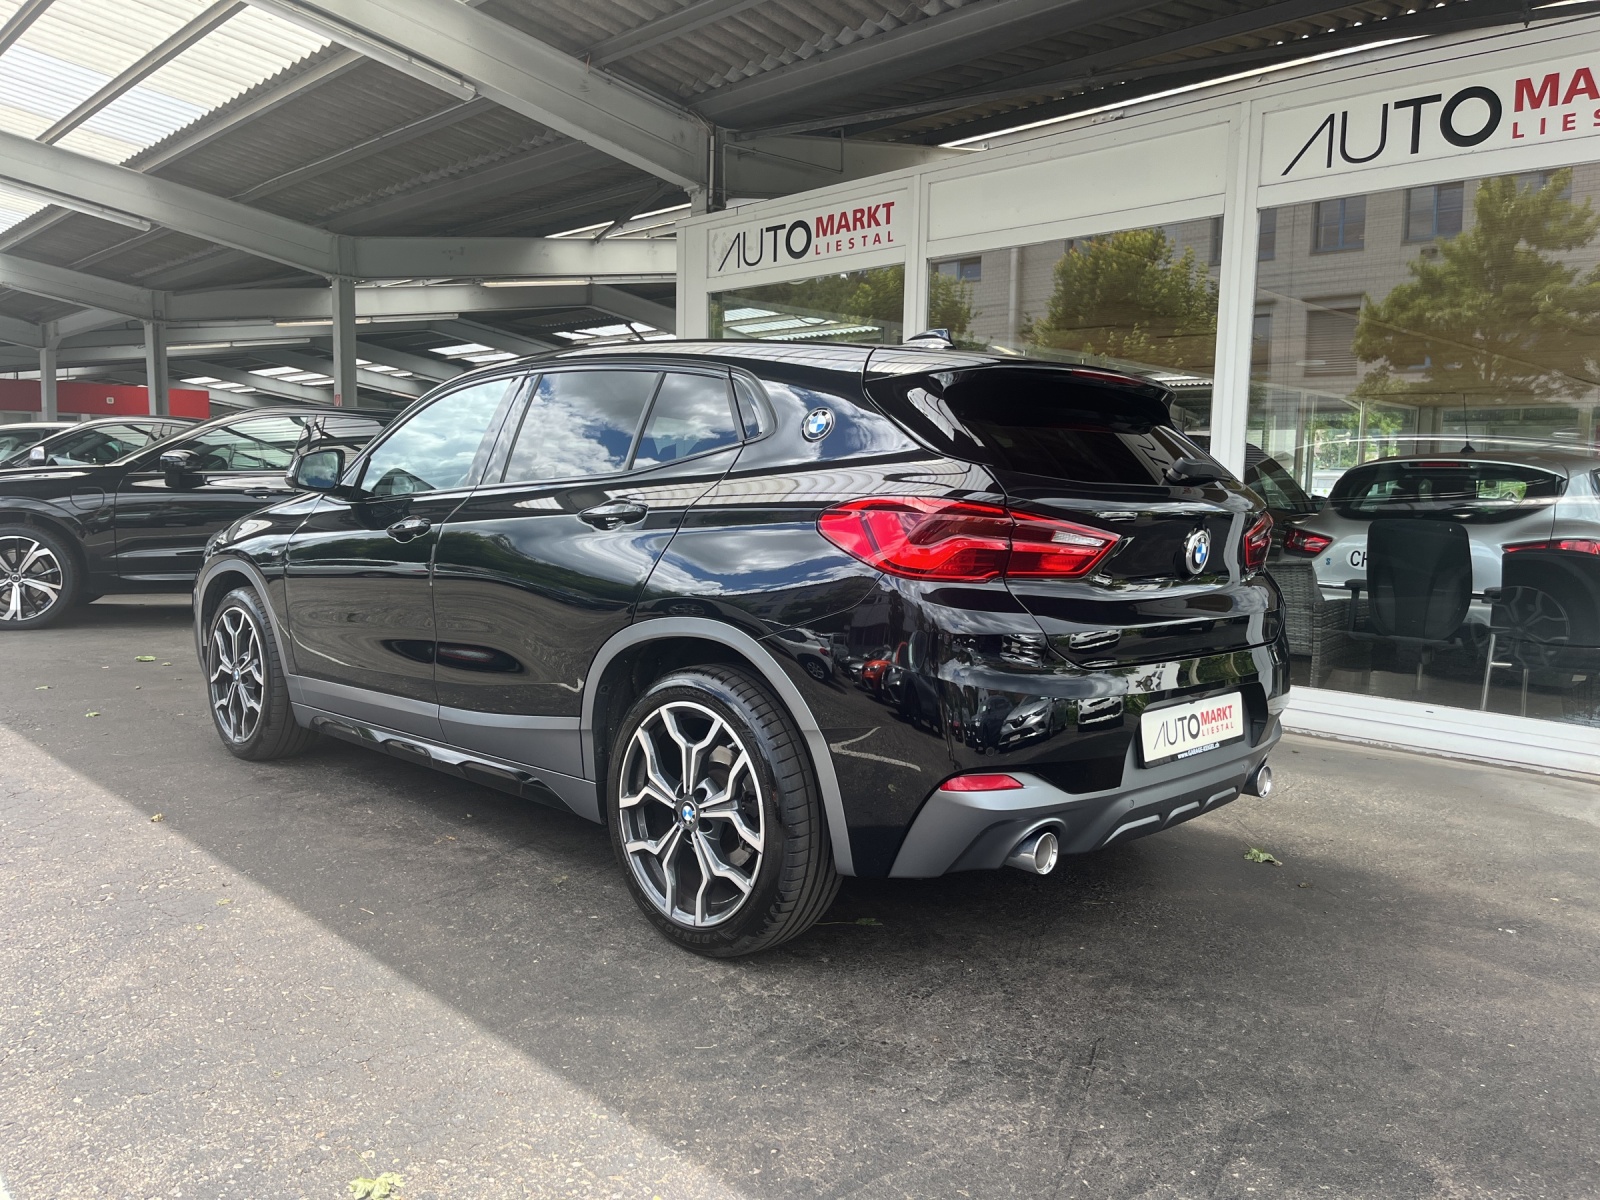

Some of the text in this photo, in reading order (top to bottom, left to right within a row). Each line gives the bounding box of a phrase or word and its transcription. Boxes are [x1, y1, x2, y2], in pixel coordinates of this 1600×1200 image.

[1281, 86, 1502, 175] AUTO
[718, 201, 895, 271] AUTO MARKT
[815, 231, 894, 255] LIESTAL
[1154, 705, 1233, 750] AUTO MARKT
[1202, 722, 1234, 737] LIESTAL
